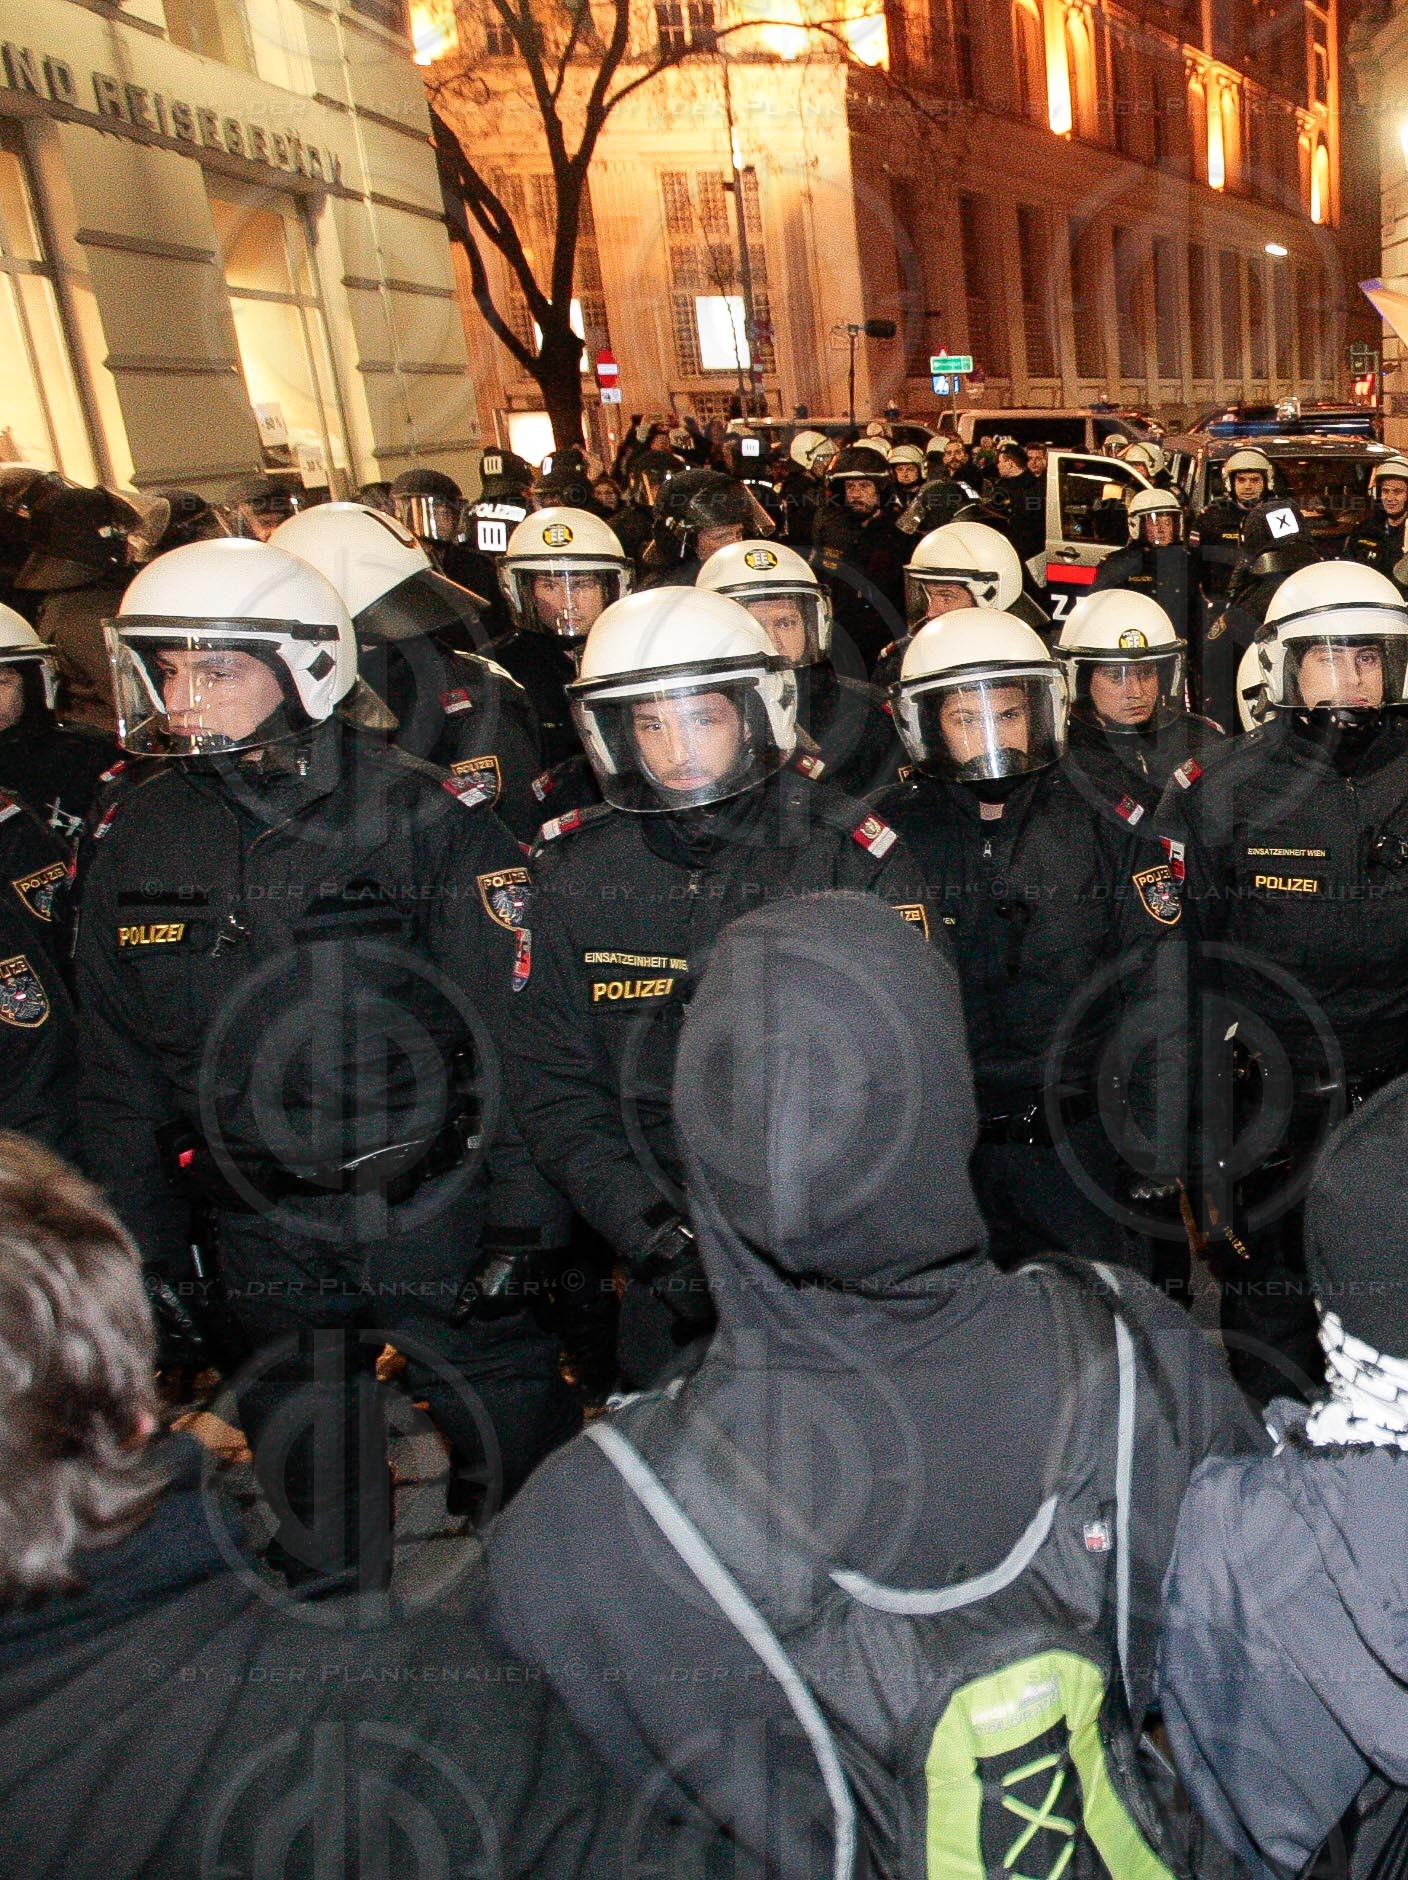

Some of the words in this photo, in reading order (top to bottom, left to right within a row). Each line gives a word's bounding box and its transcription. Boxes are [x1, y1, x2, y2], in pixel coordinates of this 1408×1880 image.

[754, 551, 769, 565] EE
[1248, 848, 1305, 857] EINSATZEINHEIT
[1255, 875, 1318, 893] POLIZEI
[118, 923, 184, 946] POLIZEI
[585, 952, 668, 968] EINSATZEINHEIT
[669, 958, 689, 973] WIE
[593, 978, 674, 1002] POLIZEI
